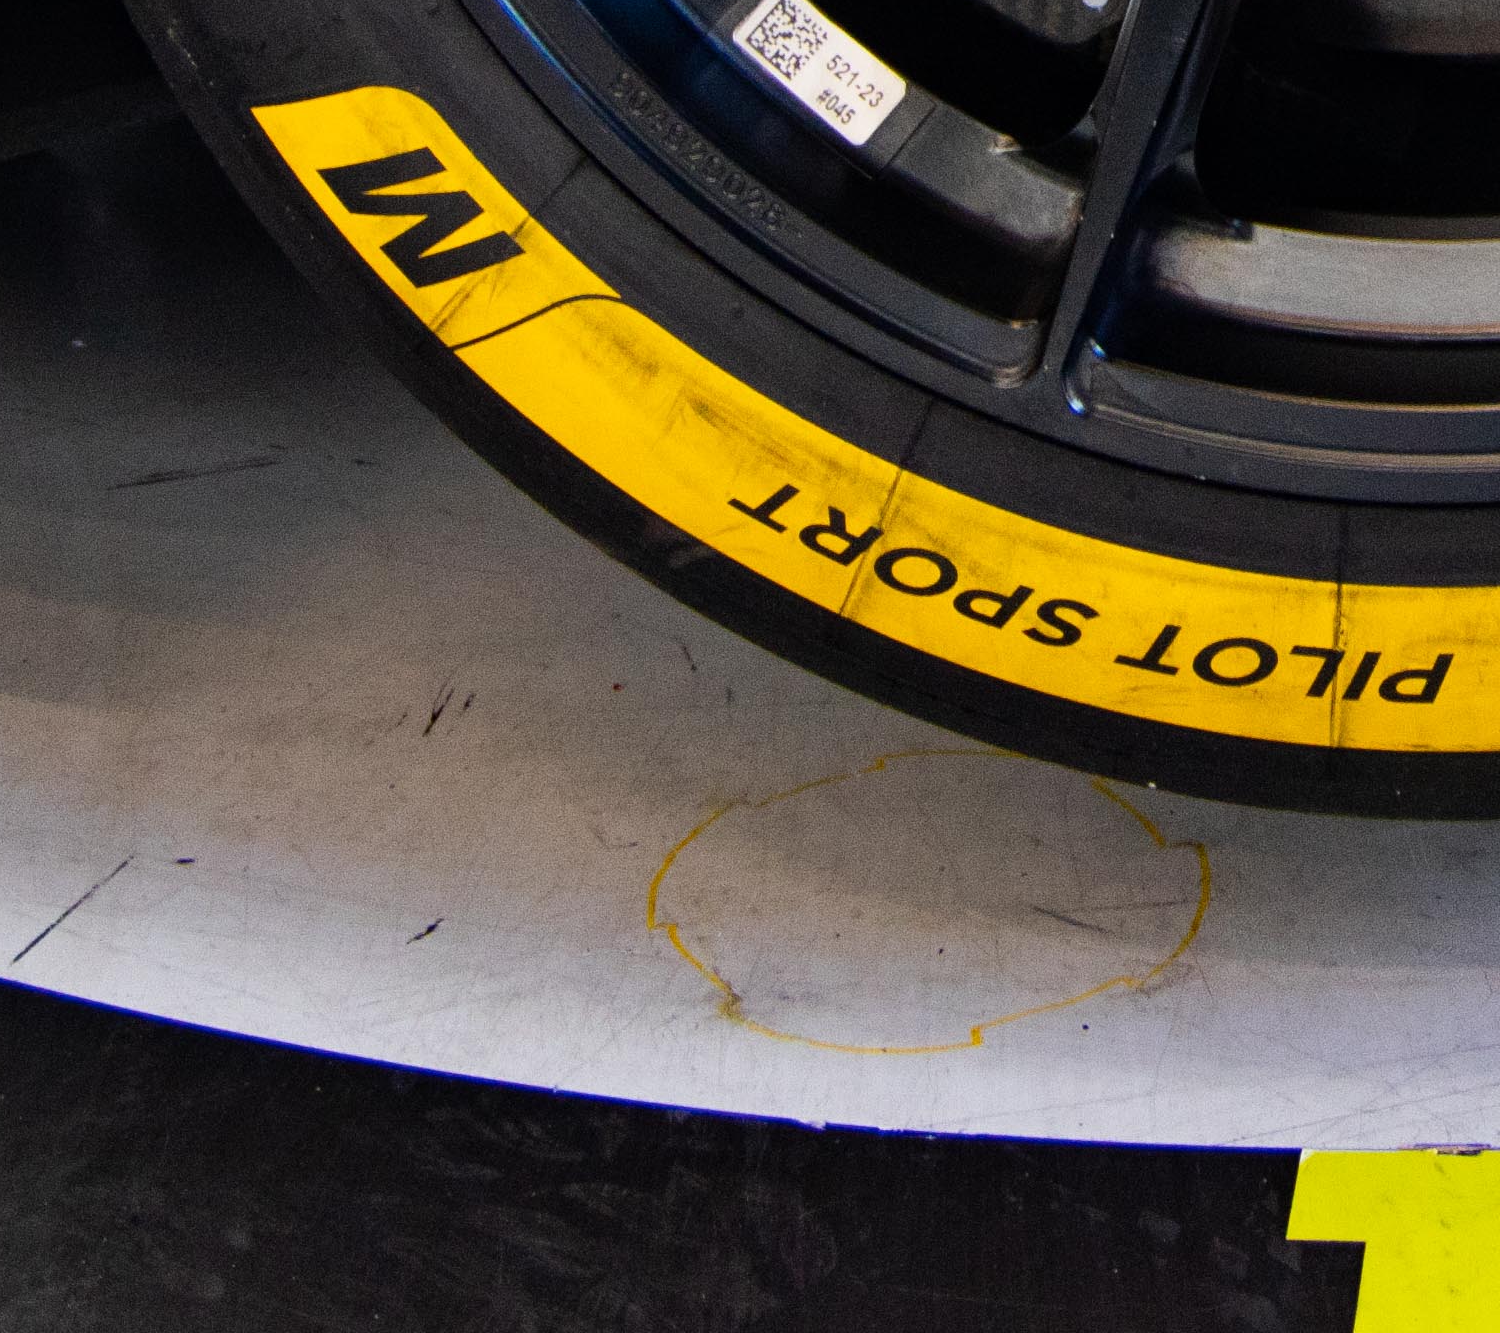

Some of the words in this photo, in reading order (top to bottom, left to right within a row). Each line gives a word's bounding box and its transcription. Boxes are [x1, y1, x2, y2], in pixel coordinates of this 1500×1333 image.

[816, 88, 856, 125] #045
[826, 53, 884, 109] 521-23
[316, 144, 528, 290] M
[725, 481, 1102, 648] SPORT
[1111, 622, 1457, 705] PILOT
